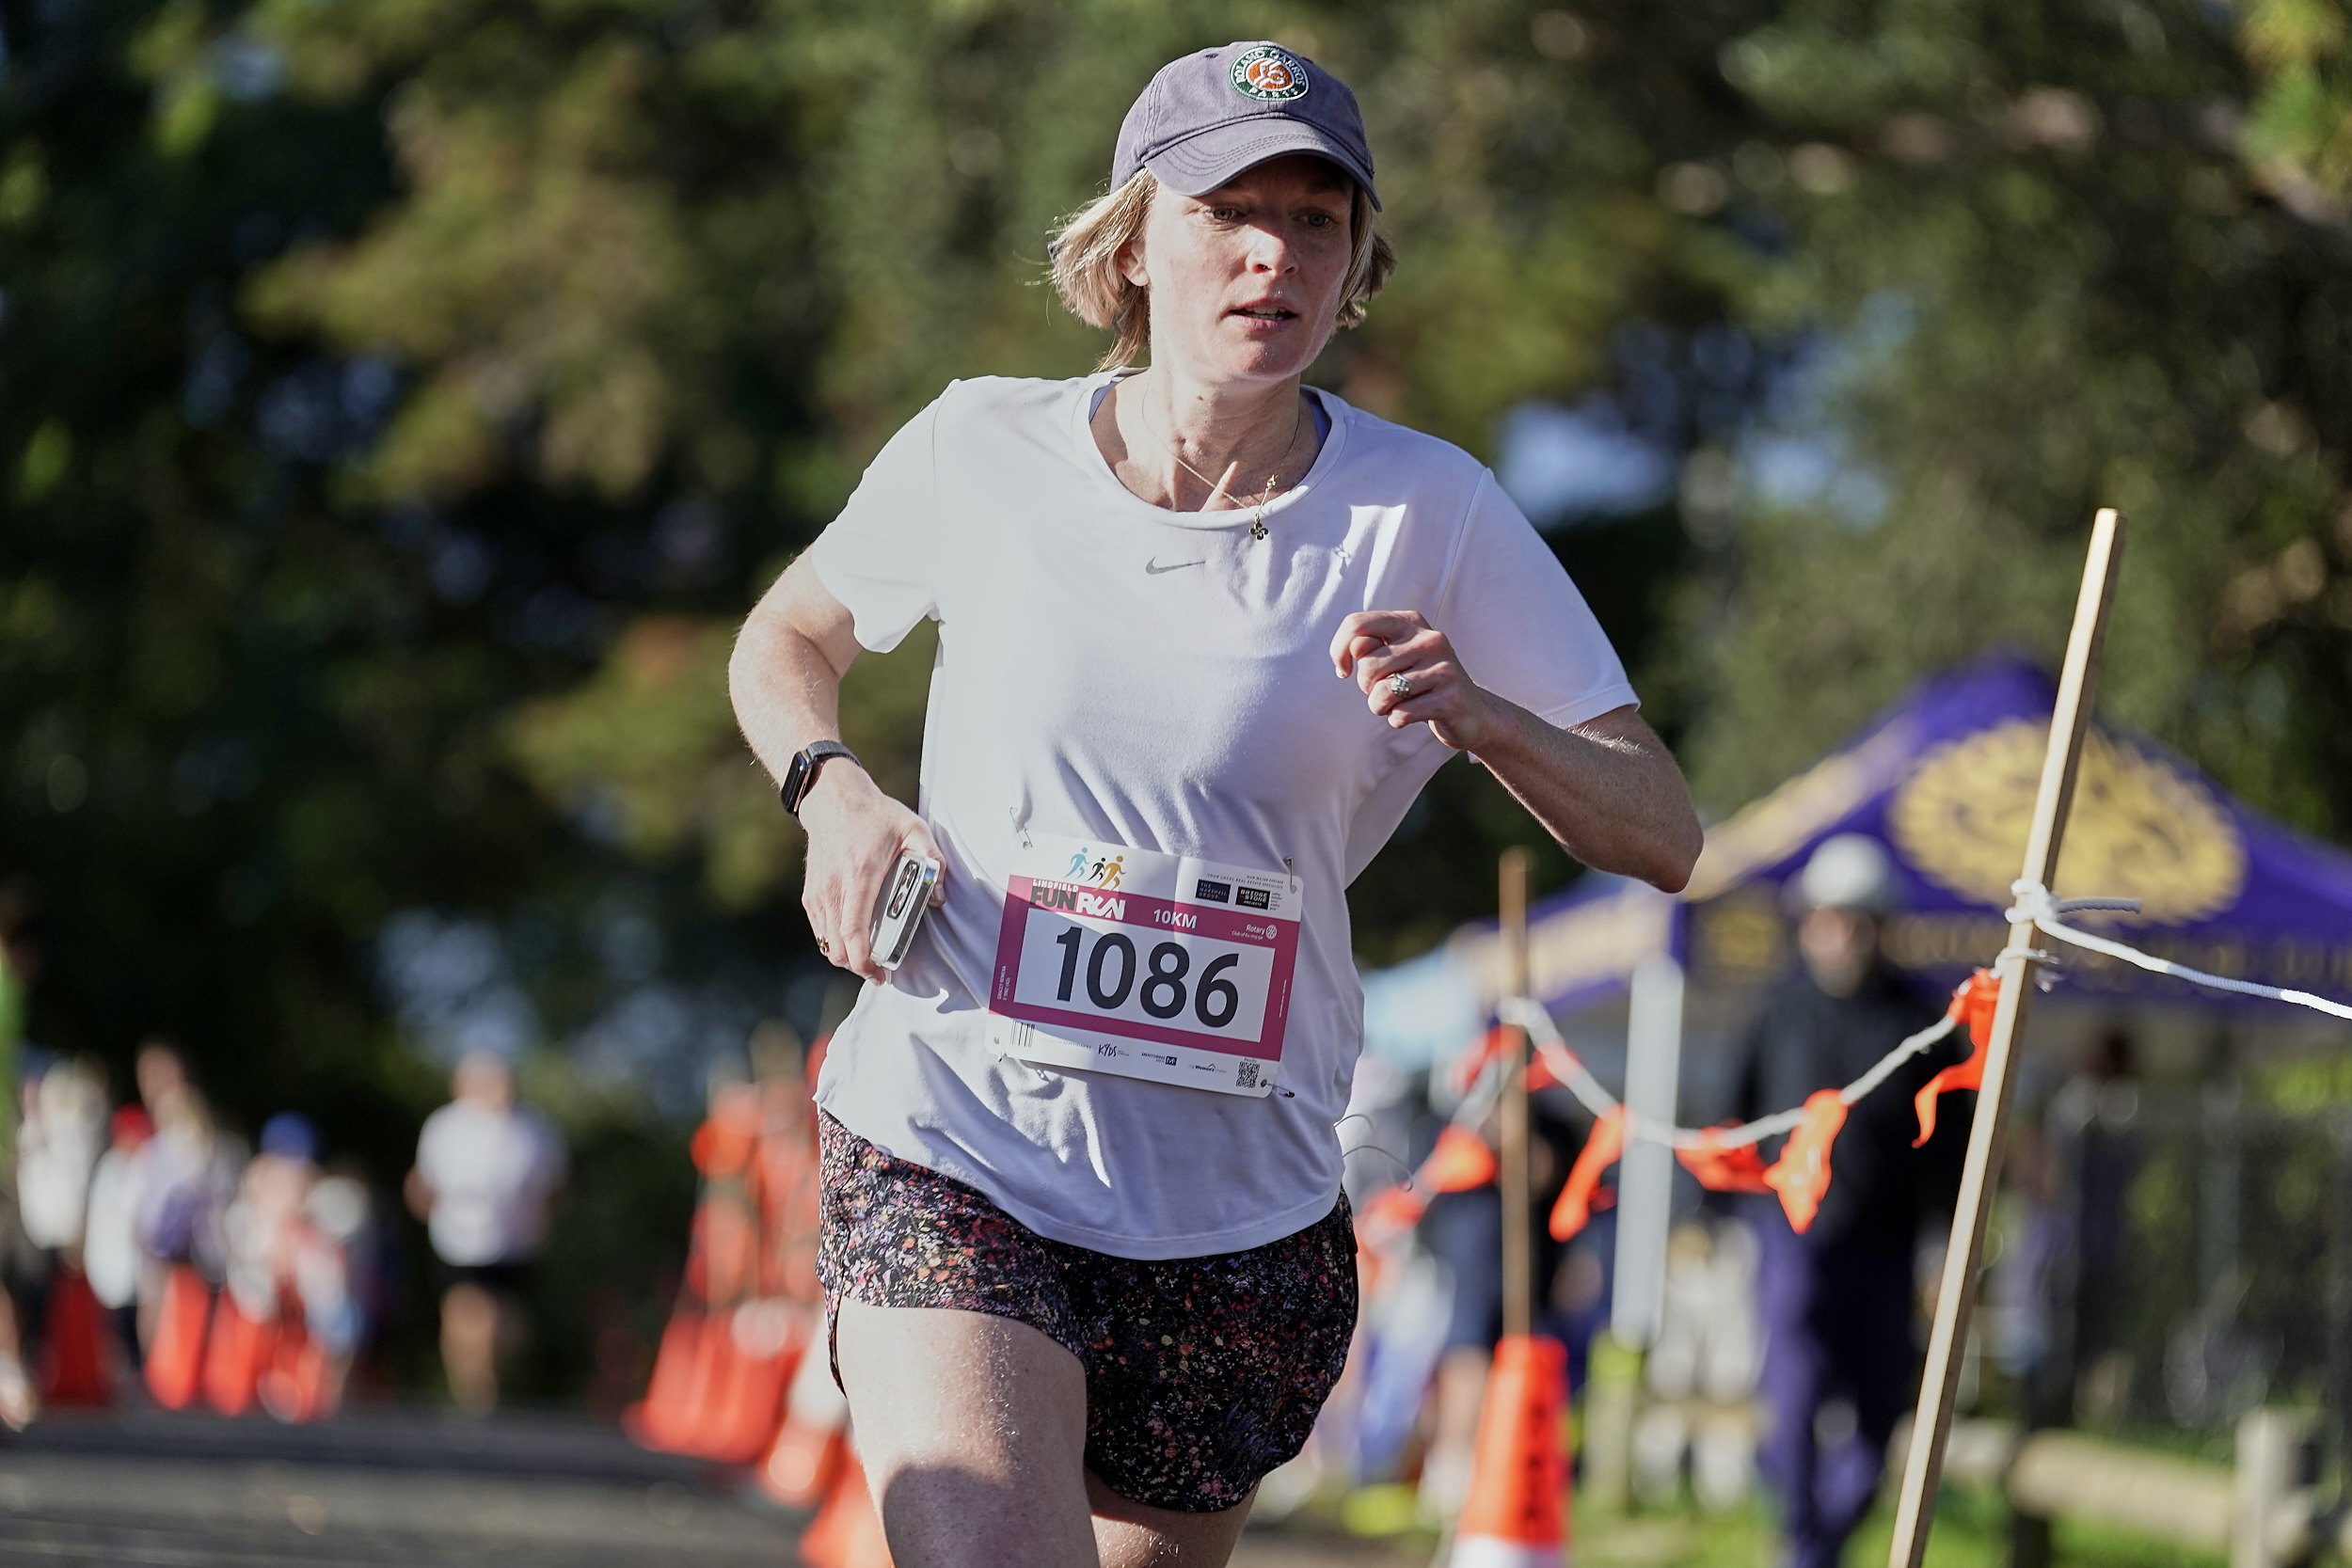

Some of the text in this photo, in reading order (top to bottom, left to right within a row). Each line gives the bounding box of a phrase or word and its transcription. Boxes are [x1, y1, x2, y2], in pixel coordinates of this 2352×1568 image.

[1032, 879, 1079, 893] LINDFIELD
[1029, 886, 1126, 921] FUN RUN
[1152, 908, 1198, 929] 10KM
[1246, 924, 1265, 936] Rotary
[1057, 926, 1240, 1028] 1086
[1097, 1043, 1118, 1058] KYDS
